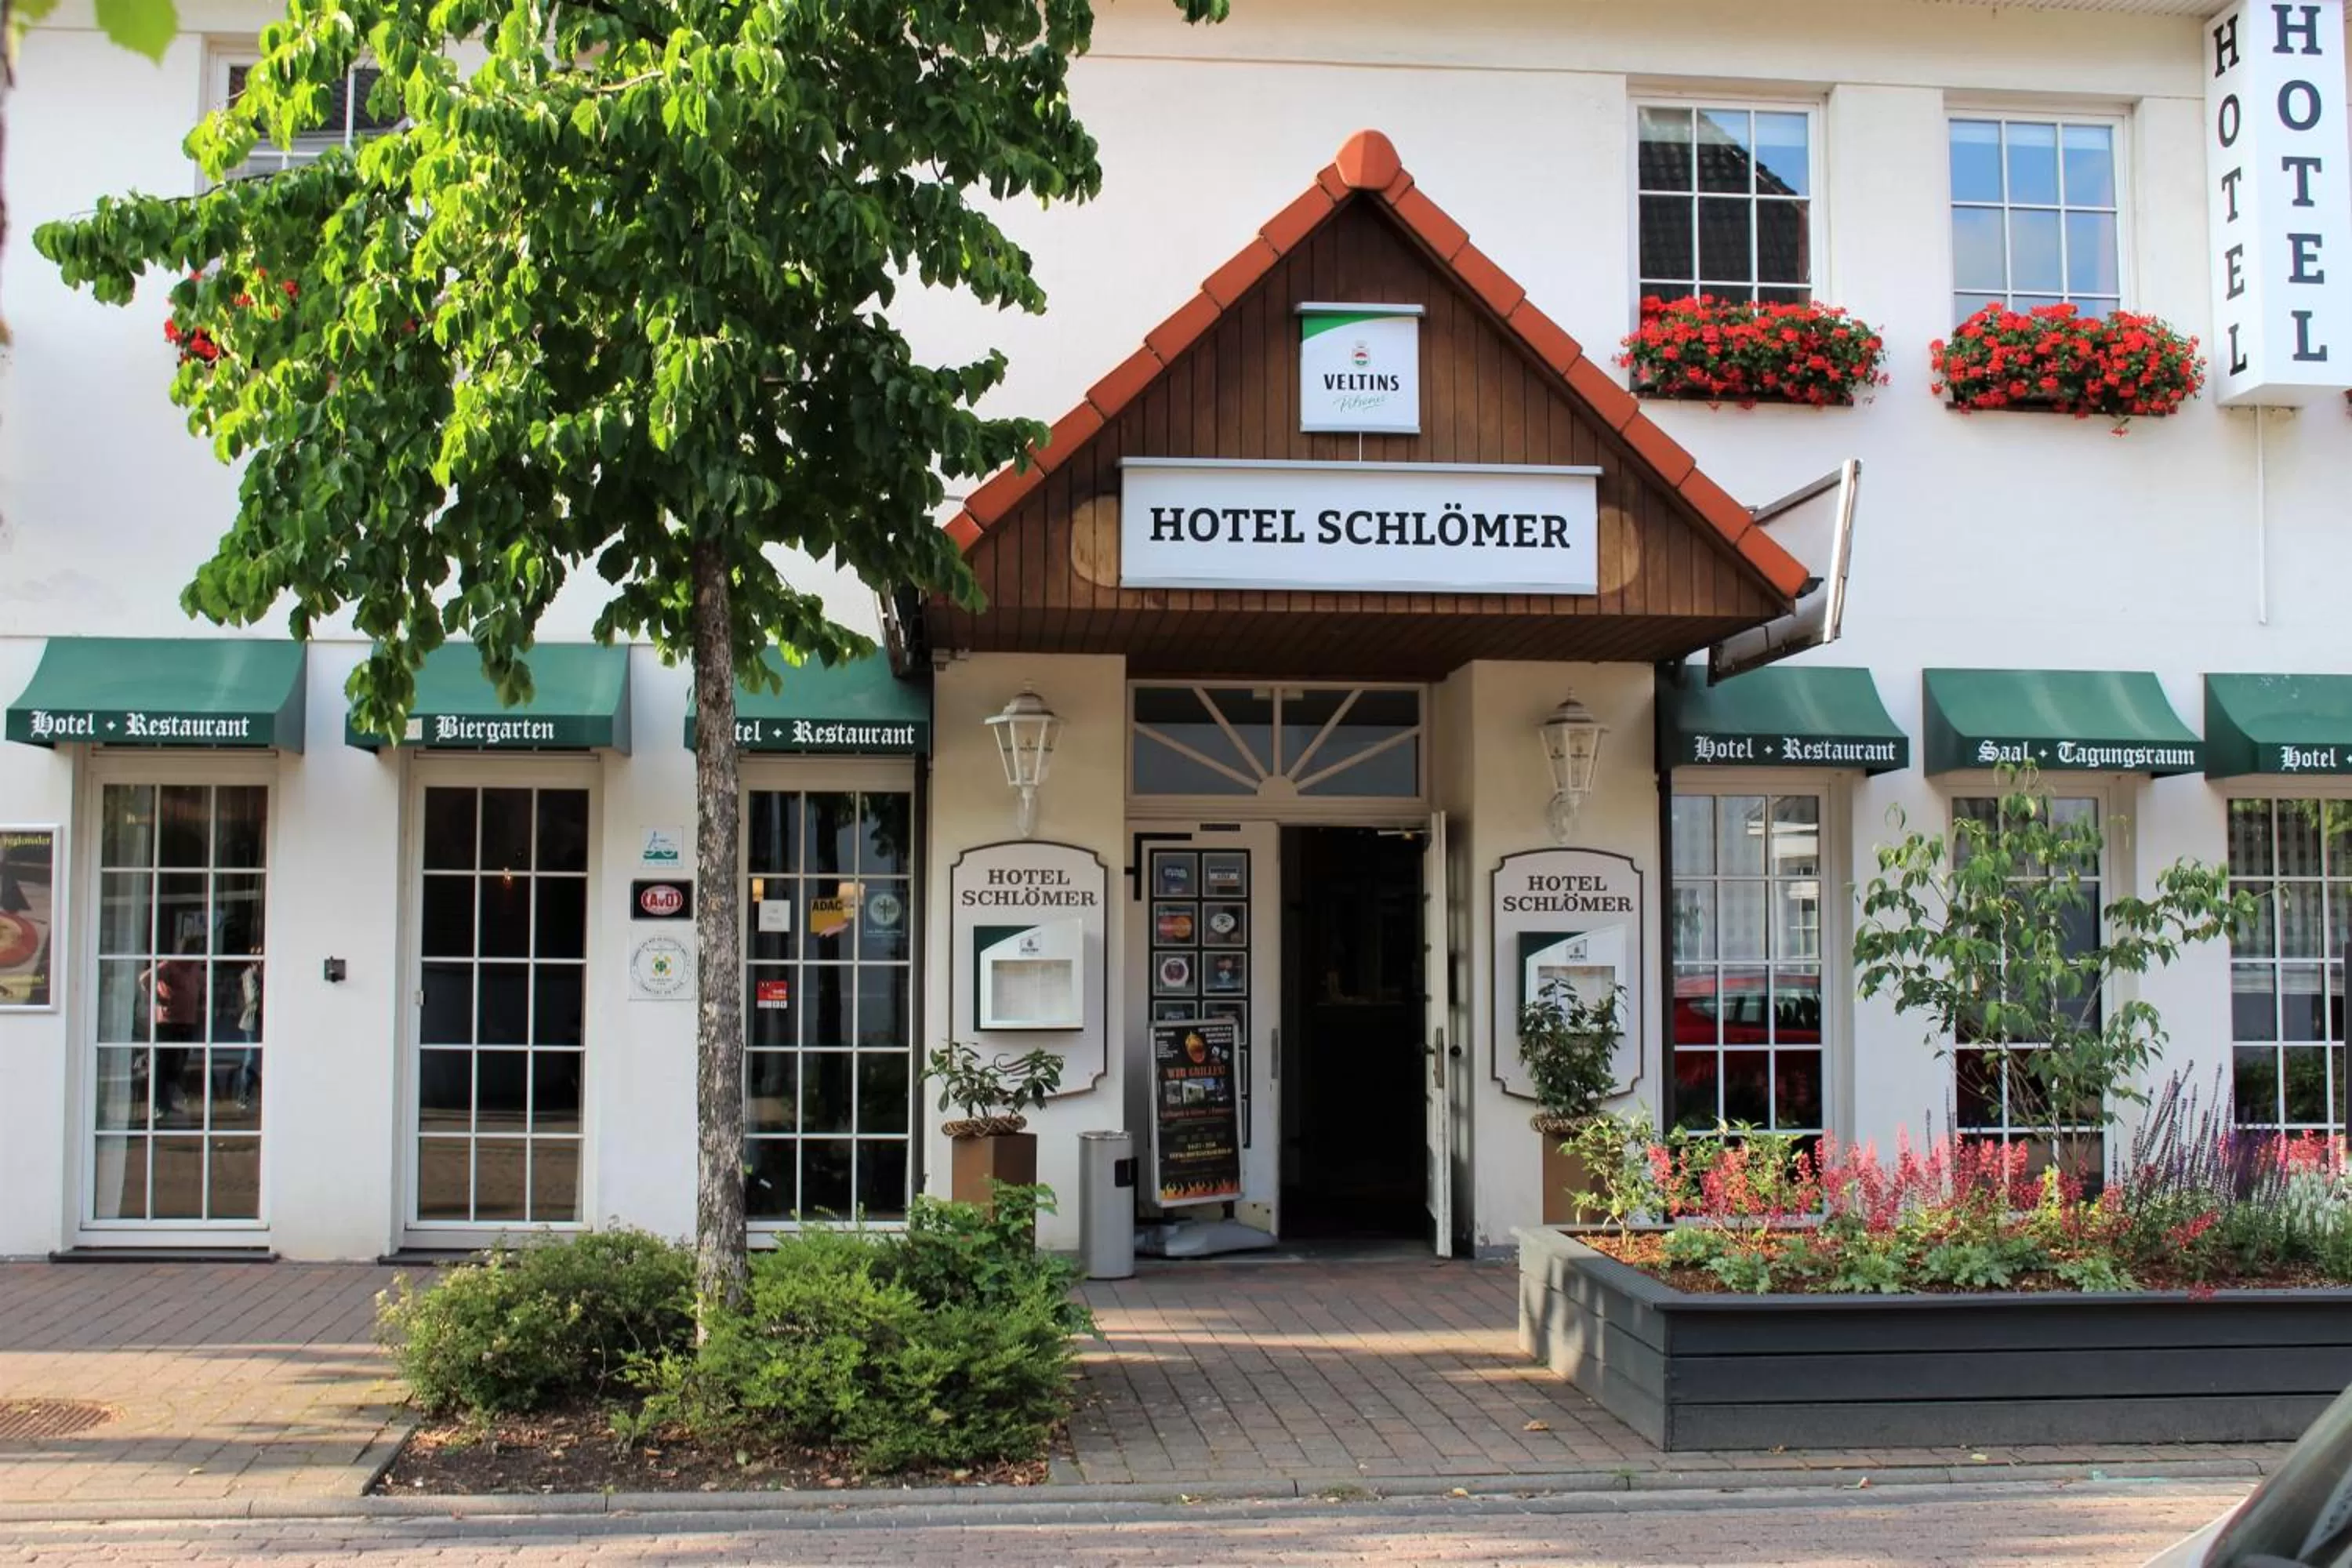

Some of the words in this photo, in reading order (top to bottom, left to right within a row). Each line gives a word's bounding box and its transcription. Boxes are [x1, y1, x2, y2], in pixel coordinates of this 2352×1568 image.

[2212, 13, 2247, 378] HOTEL
[2271, 4, 2328, 362] HOTEL
[1323, 373, 1399, 391] VELTINS
[1149, 507, 1305, 543] HOTEL
[1317, 503, 1570, 548] SCHLÖMER
[31, 710, 95, 737] Hotel
[125, 713, 250, 738] Restaurant
[436, 714, 554, 743] Biergarten
[734, 720, 762, 742] tel
[792, 720, 915, 745] Restaurant
[1694, 735, 1754, 762] Hotel
[1782, 738, 1896, 760] Restaurant
[1977, 740, 2031, 762] Saal
[2056, 741, 2195, 768] Tagungsraum
[2281, 746, 2337, 771] Hotel
[989, 869, 1070, 885] HOTEL
[1528, 876, 1608, 891] HOTEL
[812, 900, 843, 912] ADAC
[962, 887, 1098, 906] SCHLÖMER
[1503, 893, 1634, 912] SCHLÖMER
